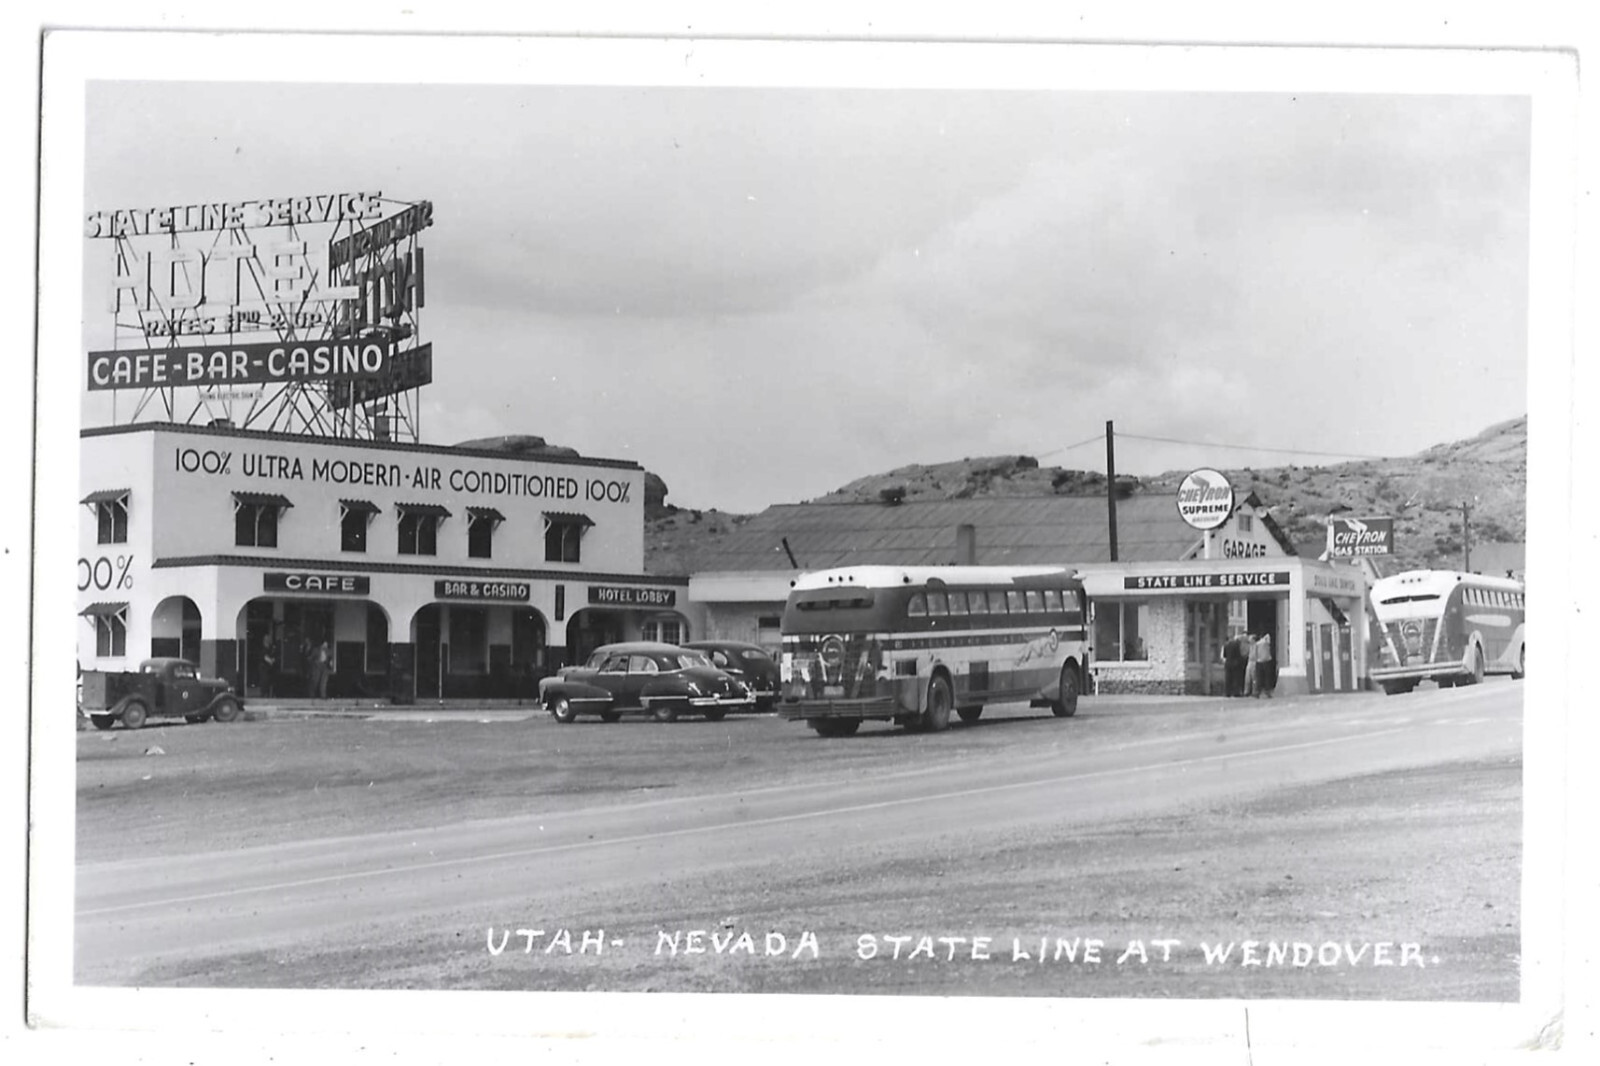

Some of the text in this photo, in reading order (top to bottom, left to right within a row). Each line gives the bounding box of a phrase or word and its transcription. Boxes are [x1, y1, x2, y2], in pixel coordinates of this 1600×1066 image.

[257, 190, 382, 226] SERVICE
[109, 239, 360, 314] HOTEL
[147, 317, 216, 336] RATES
[295, 311, 322, 330] UP
[175, 448, 232, 475] 100%
[242, 453, 303, 480] ULTRA
[450, 469, 578, 499] CONDITIONED
[585, 479, 631, 504] 100%
[1179, 480, 1231, 504] CHEVRON
[1182, 504, 1229, 515] SUPREME
[1335, 524, 1387, 546] CHEVRON
[1223, 538, 1266, 560] GARAGE
[1334, 545, 1388, 556] GAS STATION
[285, 575, 355, 591] CAFE
[444, 582, 527, 598] BAR & CASINO
[1137, 573, 1276, 588] STATE LINE SERVICE
[598, 588, 671, 604] HOTEL LOBBY
